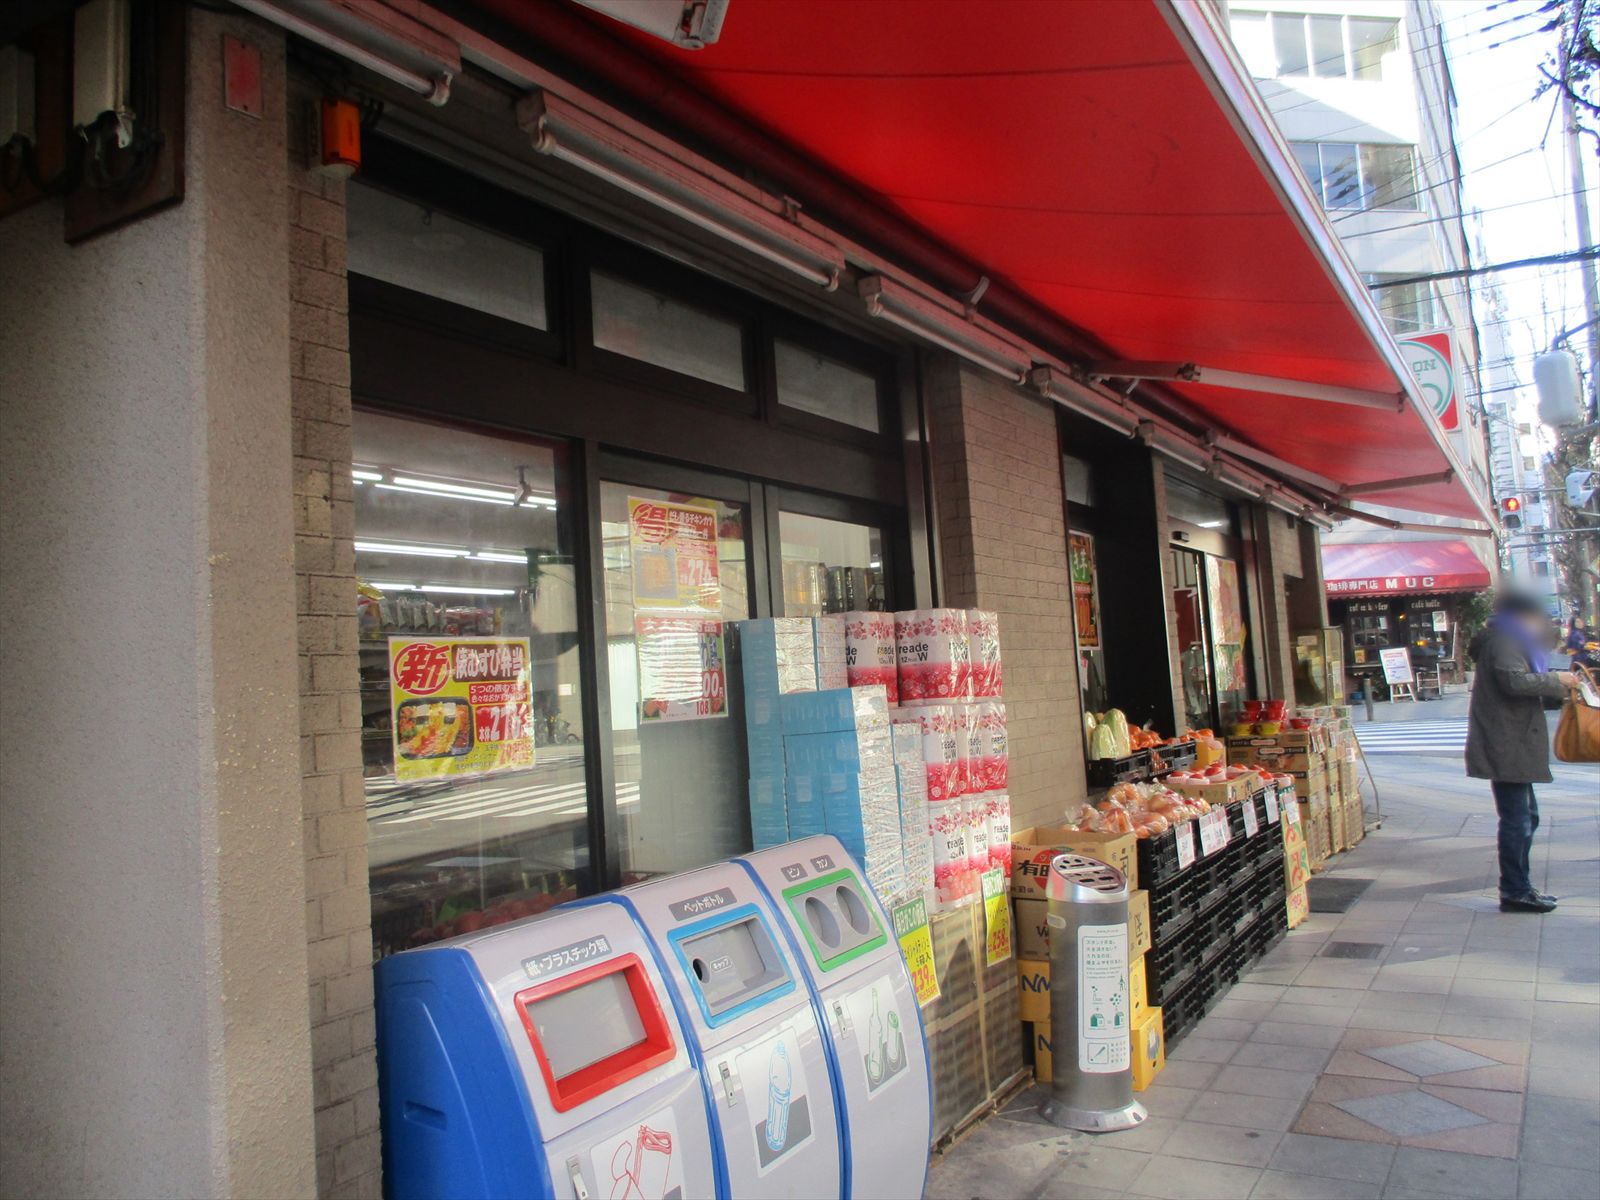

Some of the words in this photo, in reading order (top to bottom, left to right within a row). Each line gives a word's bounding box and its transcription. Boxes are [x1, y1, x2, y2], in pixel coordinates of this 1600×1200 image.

[456, 647, 524, 679] 俵むすび弁当
[898, 642, 929, 654] reade
[397, 644, 450, 690] 新
[683, 893, 725, 913] ペットボトル
[525, 938, 609, 977] 紙・プラスチック類
